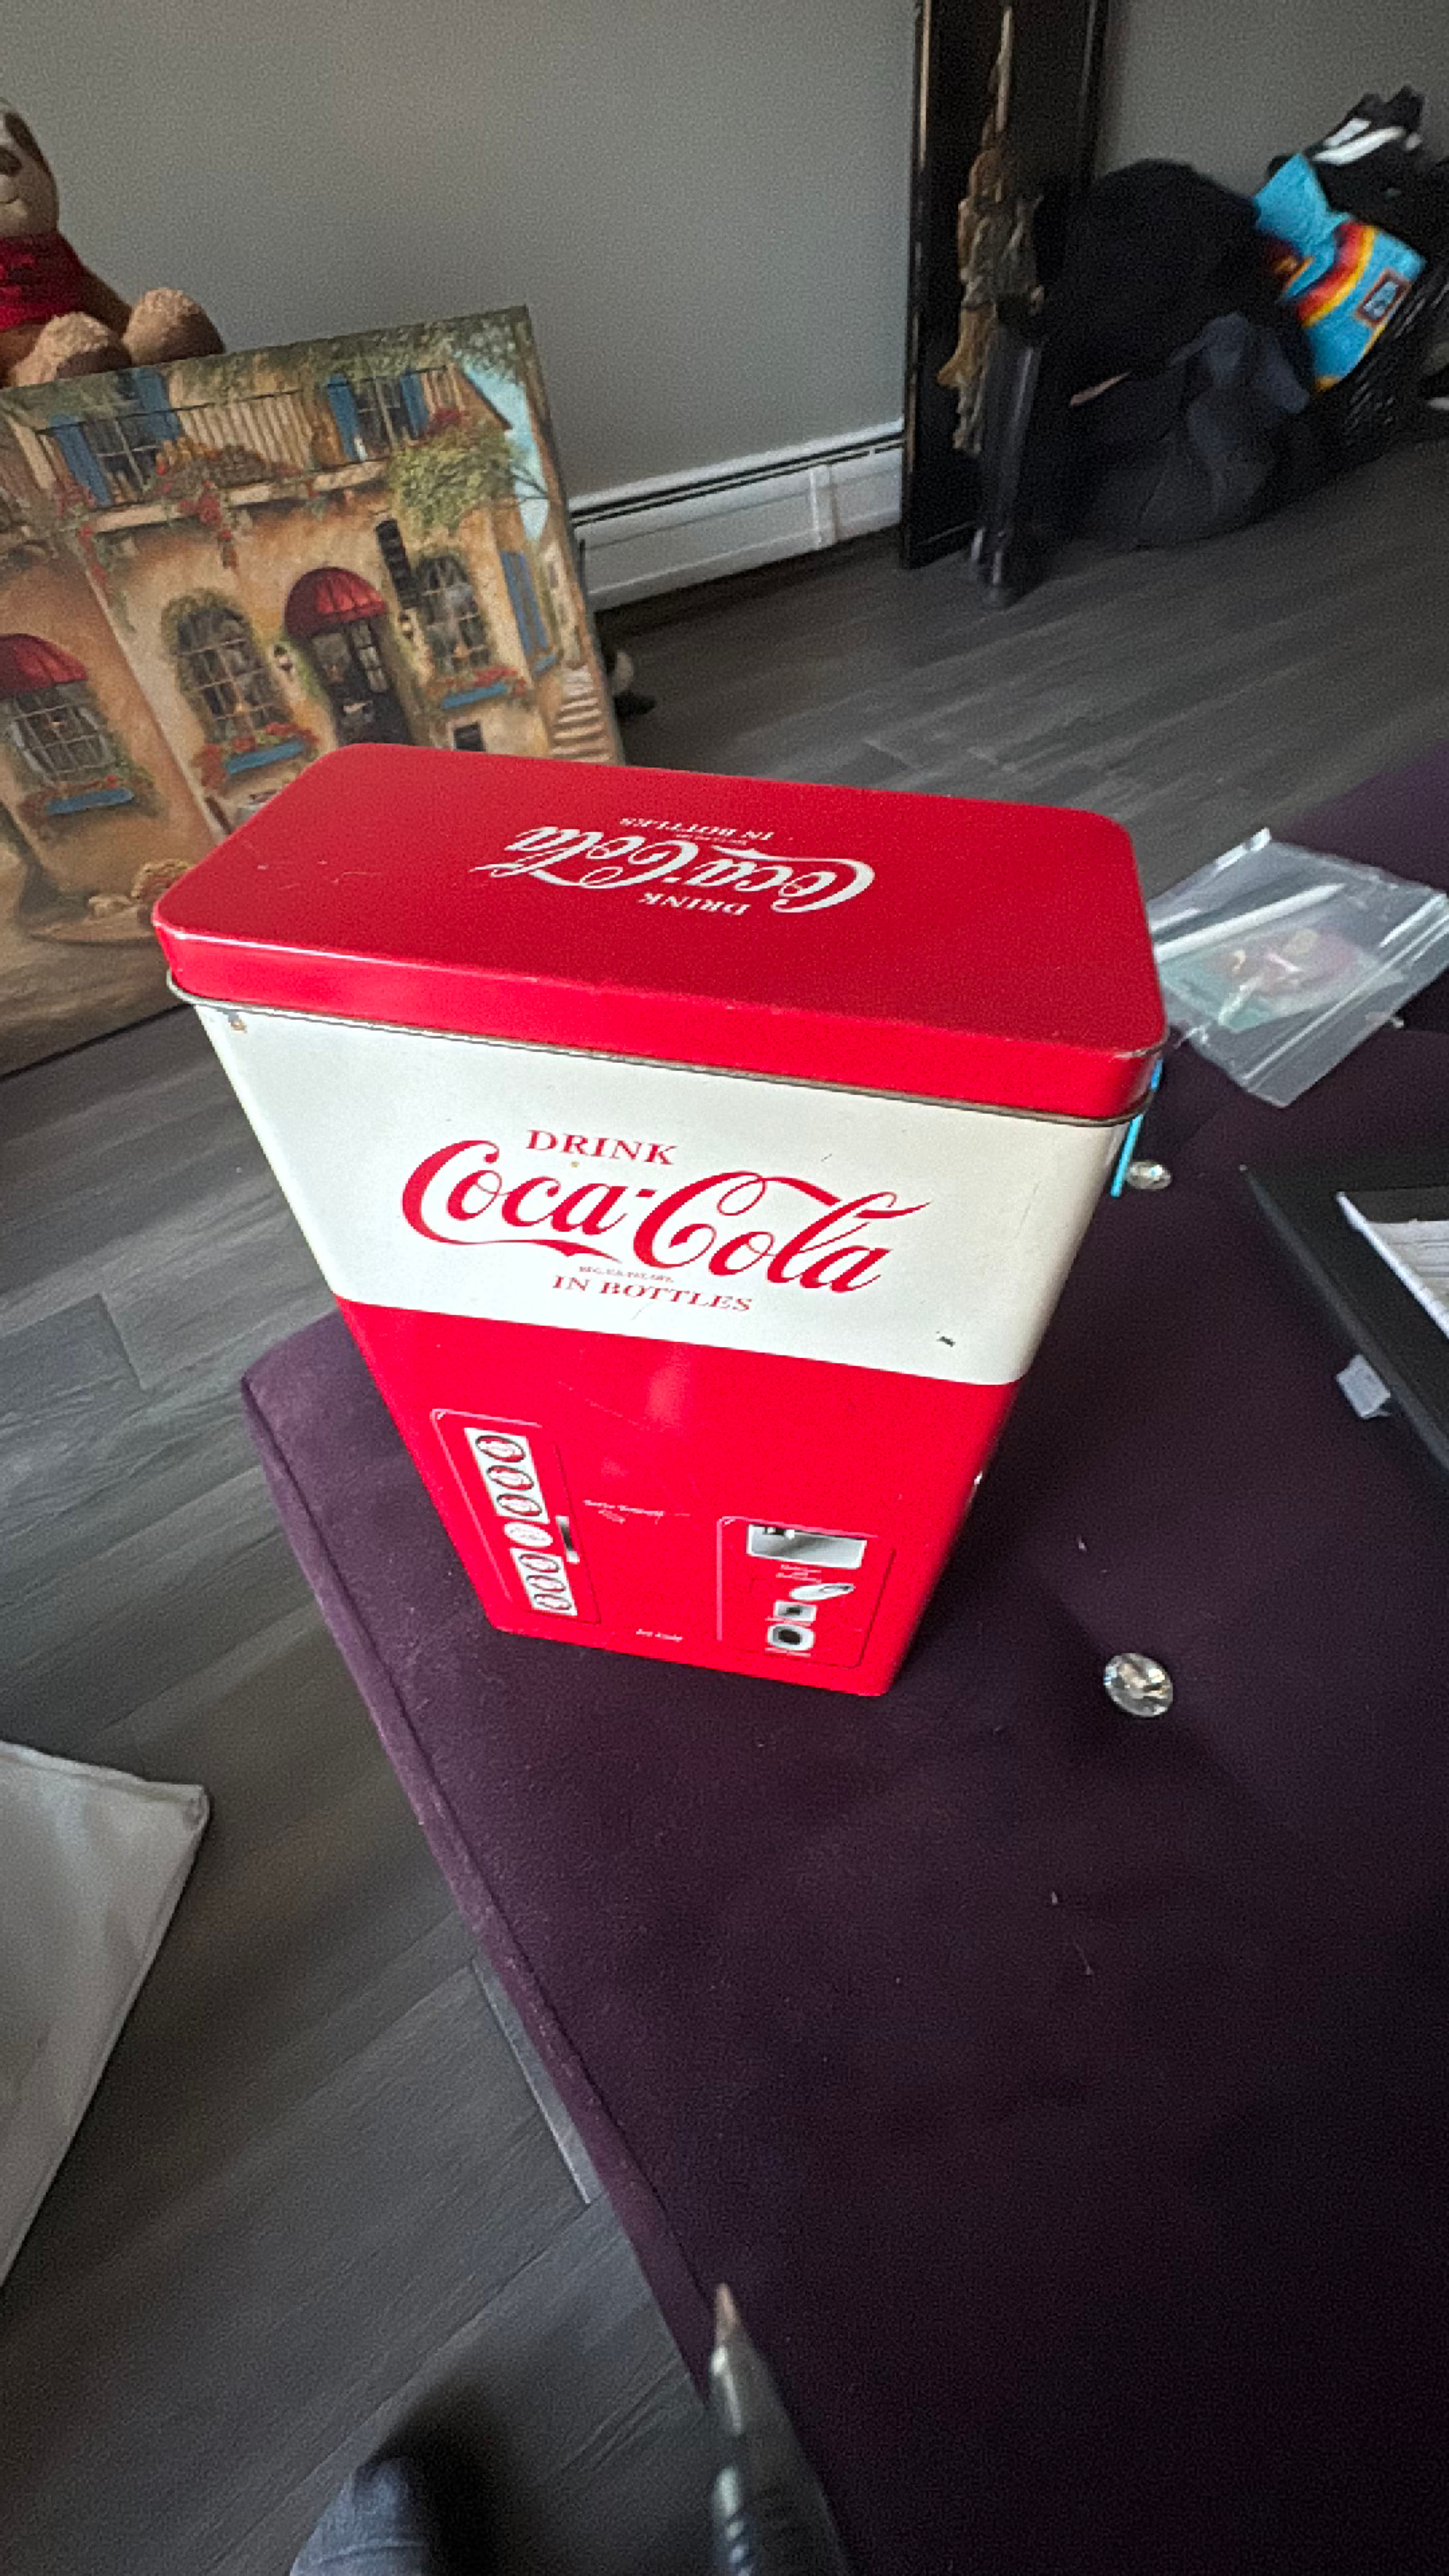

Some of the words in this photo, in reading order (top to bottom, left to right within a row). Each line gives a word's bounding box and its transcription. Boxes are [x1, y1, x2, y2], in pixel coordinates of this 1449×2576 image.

[741, 830, 774, 840] IN
[638, 892, 751, 916] DRINK
[526, 1129, 677, 1166] DRINK
[401, 1140, 932, 1293] Coca-Cola
[552, 1276, 590, 1292] IN
[599, 1283, 753, 1312] BOTTLES
